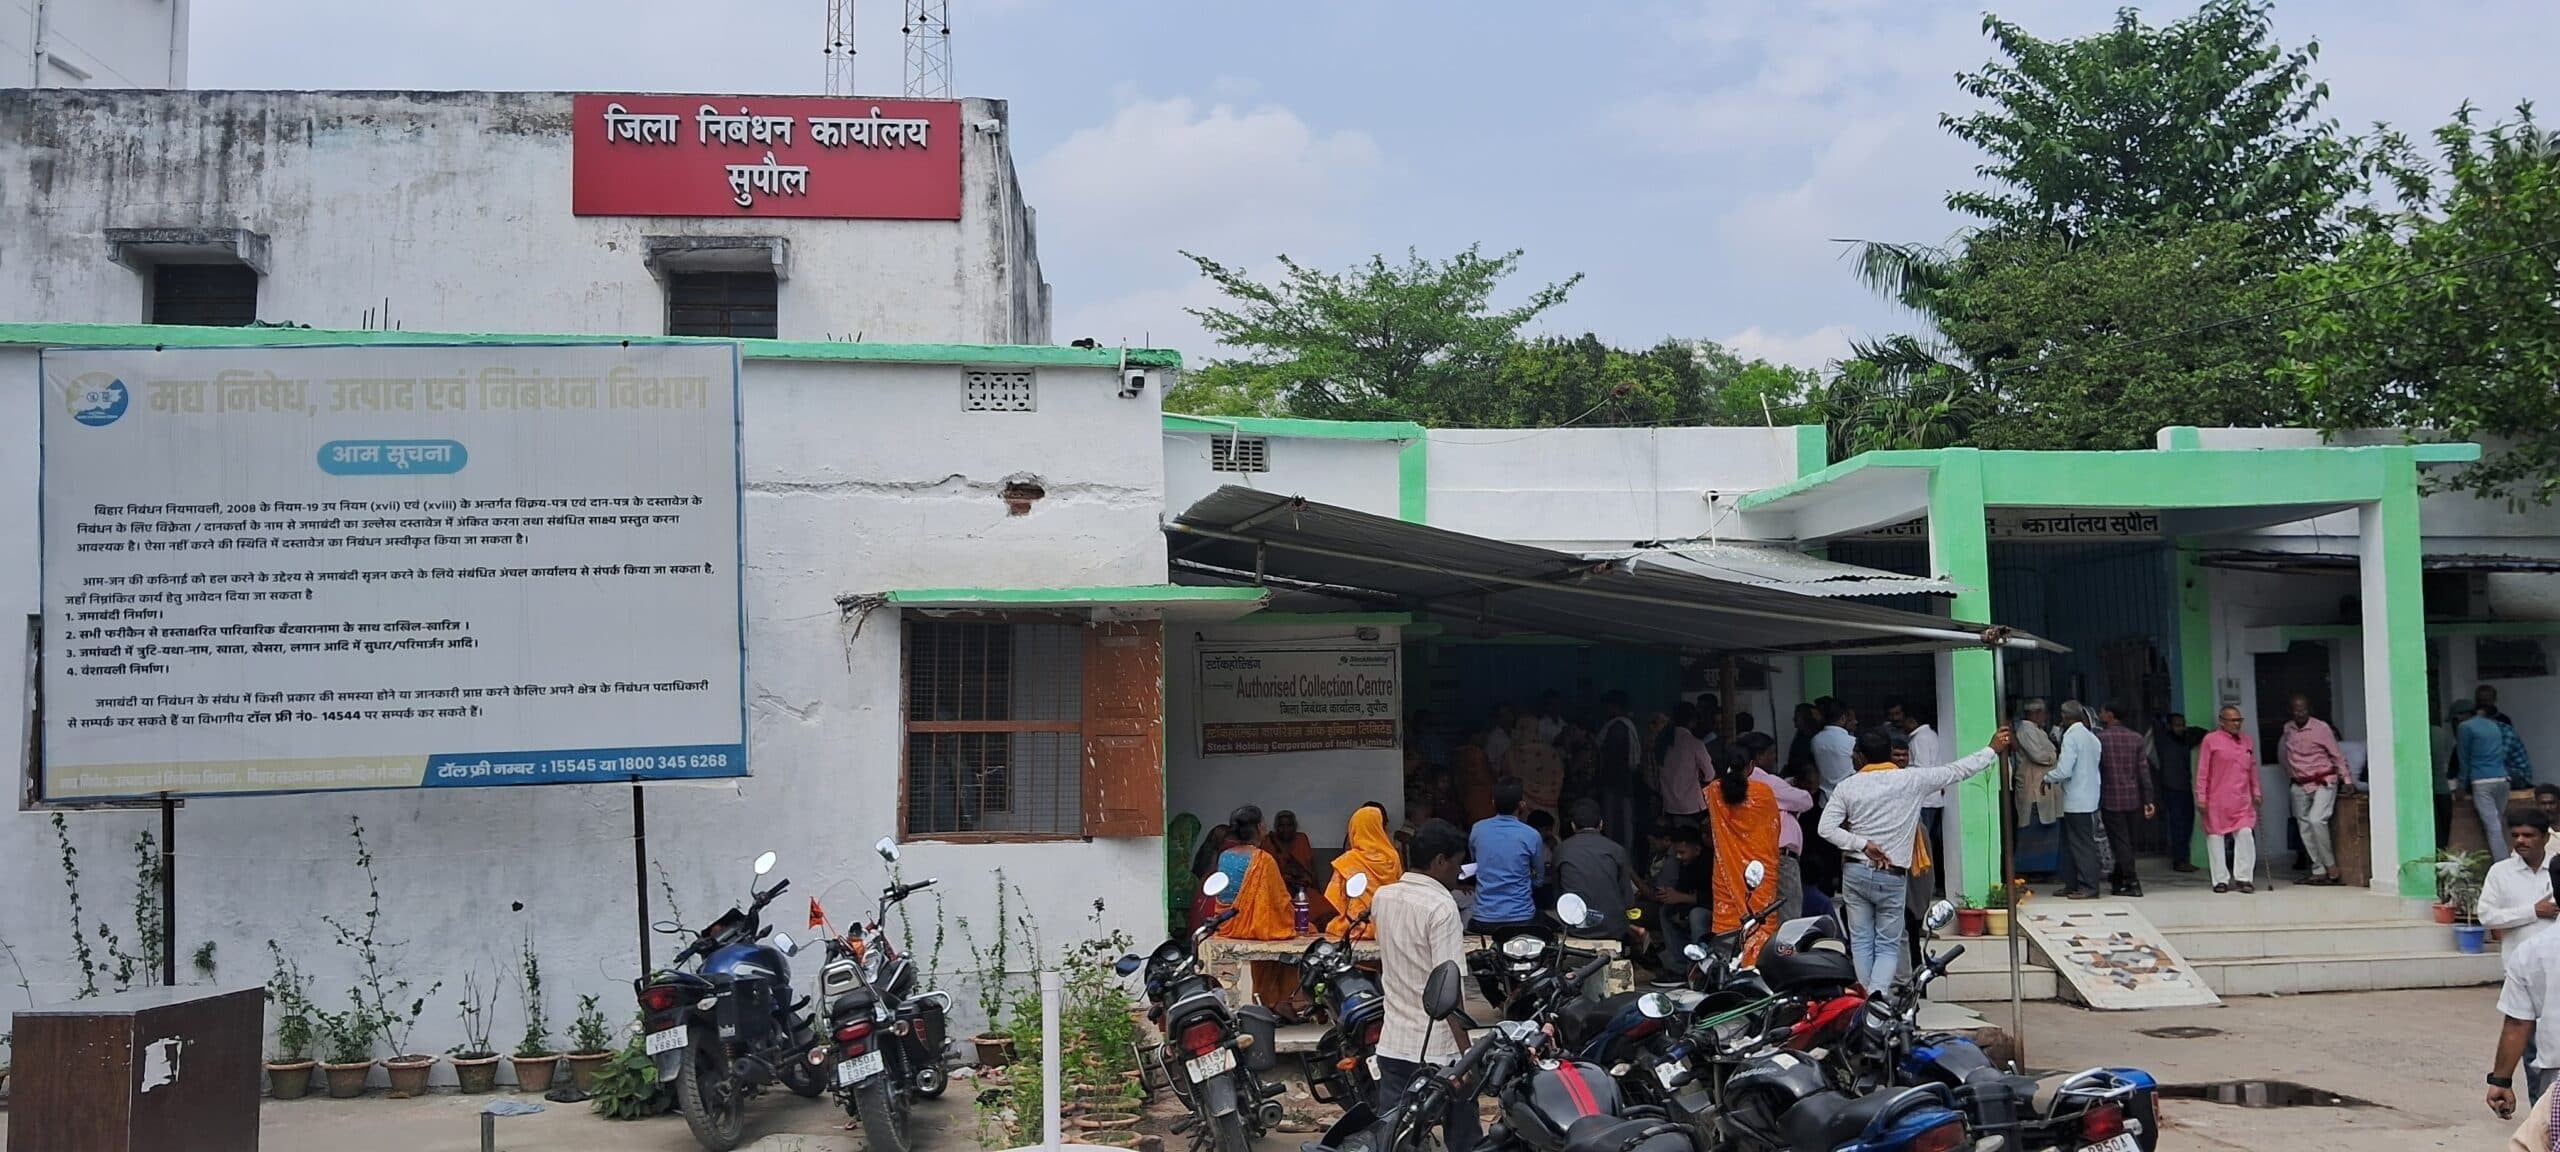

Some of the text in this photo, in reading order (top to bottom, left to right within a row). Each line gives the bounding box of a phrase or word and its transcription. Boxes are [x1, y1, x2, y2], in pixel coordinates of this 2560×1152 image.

[604, 103, 930, 149] जिला निबंधन कार्यालय
[724, 151, 809, 207] सुपौल
[147, 379, 208, 415] मद्य
[326, 377, 416, 412] उत्पाद
[421, 368, 470, 411] एवं
[475, 367, 600, 410] निबंधन
[606, 366, 710, 409] विभाग
[333, 445, 452, 469] आम सूचना
[94, 503, 123, 515] बिहार
[126, 503, 162, 514] निबंधन
[165, 502, 222, 515] नियमावली,
[227, 504, 256, 513] 2008
[259, 501, 270, 512] के
[274, 500, 318, 511] नियम-19
[321, 502, 336, 511] उप
[339, 499, 367, 510] नियम
[370, 501, 400, 512] (xvii)
[403, 499, 420, 509] एवं
[423, 500, 456, 511] (xviii)
[459, 498, 471, 508] के
[474, 497, 512, 508] अन्तर्गत
[570, 497, 586, 507] एवं
[589, 498, 629, 507] दान-पत्र
[632, 495, 644, 506] के
[646, 495, 688, 506] दस्तावेज
[691, 495, 702, 505] के
[83, 577, 125, 585] आम-जन
[128, 574, 143, 584] की
[146, 573, 188, 585] कठिनाई
[190, 572, 206, 583] को
[208, 575, 227, 584] हल
[230, 571, 254, 582] करने
[257, 571, 269, 582] के
[304, 570, 314, 581] से
[317, 569, 358, 581] जमाबंदी
[361, 571, 387, 583] सृजन
[390, 568, 414, 579] करने
[416, 568, 428, 578] के
[456, 566, 496, 578] संबंधित
[499, 566, 528, 577] अंचल
[530, 565, 577, 576] कार्यालय
[580, 564, 589, 575] से
[592, 564, 620, 575] संपर्क
[623, 563, 650, 574] किया
[653, 566, 666, 574] जा
[669, 565, 700, 573] सकता
[138, 591, 162, 602] कार्य
[166, 591, 182, 605] हेतु
[185, 590, 222, 601] आवेदन
[225, 589, 250, 601] दिया
[252, 592, 266, 600] जा
[268, 591, 302, 599] सकता
[304, 588, 312, 600] है
[65, 613, 73, 621] 1.
[77, 609, 120, 620] जमाबंदी
[65, 631, 76, 639] 2.
[78, 627, 101, 639] सभी
[148, 626, 158, 637] से
[161, 624, 216, 637] हस्ताक्षरित
[219, 623, 275, 635] पारिवारिक
[342, 621, 354, 632] के
[357, 623, 380, 632] साथ
[66, 667, 77, 675] 4.
[80, 663, 126, 675] वंशावली
[95, 695, 137, 707] जमाबंदी
[140, 697, 154, 706] या
[156, 694, 194, 705] निबंधन
[196, 693, 208, 704] के
[211, 693, 240, 704] संबंध
[242, 692, 252, 703] में
[254, 691, 283, 703] किसी
[286, 693, 315, 702] प्रकार
[318, 690, 334, 701] की
[337, 691, 373, 700] समस्या
[376, 688, 395, 700] होने
[398, 691, 412, 699] या
[414, 686, 459, 698] जानकारी
[485, 685, 509, 696] करने
[512, 684, 546, 695] केलिए
[549, 683, 574, 695] अपने
[577, 683, 596, 693] क्षेत्र
[599, 682, 611, 693] के
[614, 681, 649, 692] निबंधन
[652, 679, 708, 691] पदाधिकारी
[1236, 673, 1393, 699] Authorised Collection Centre
[67, 717, 77, 727] से
[80, 715, 114, 727] सम्पर्क
[116, 717, 134, 726] कर
[137, 714, 166, 726] सकते
[181, 716, 194, 724] या
[198, 712, 244, 724] विभागीय
[246, 710, 272, 723] टॉल
[274, 709, 292, 722] फ्री
[321, 711, 360, 720] 14544
[364, 711, 378, 719] पर
[380, 707, 414, 719] सम्पर्क
[417, 709, 434, 717] कर
[437, 706, 466, 717] सकते
[1271, 740, 1323, 752] Corporation
[438, 762, 468, 778] टॉल
[469, 760, 491, 778] फ्री
[492, 762, 535, 777] नम्बर
[550, 759, 596, 774] 15545
[599, 761, 617, 772] या
[618, 757, 655, 771] 1800
[658, 756, 687, 770] 345
[689, 754, 727, 768] 6268
